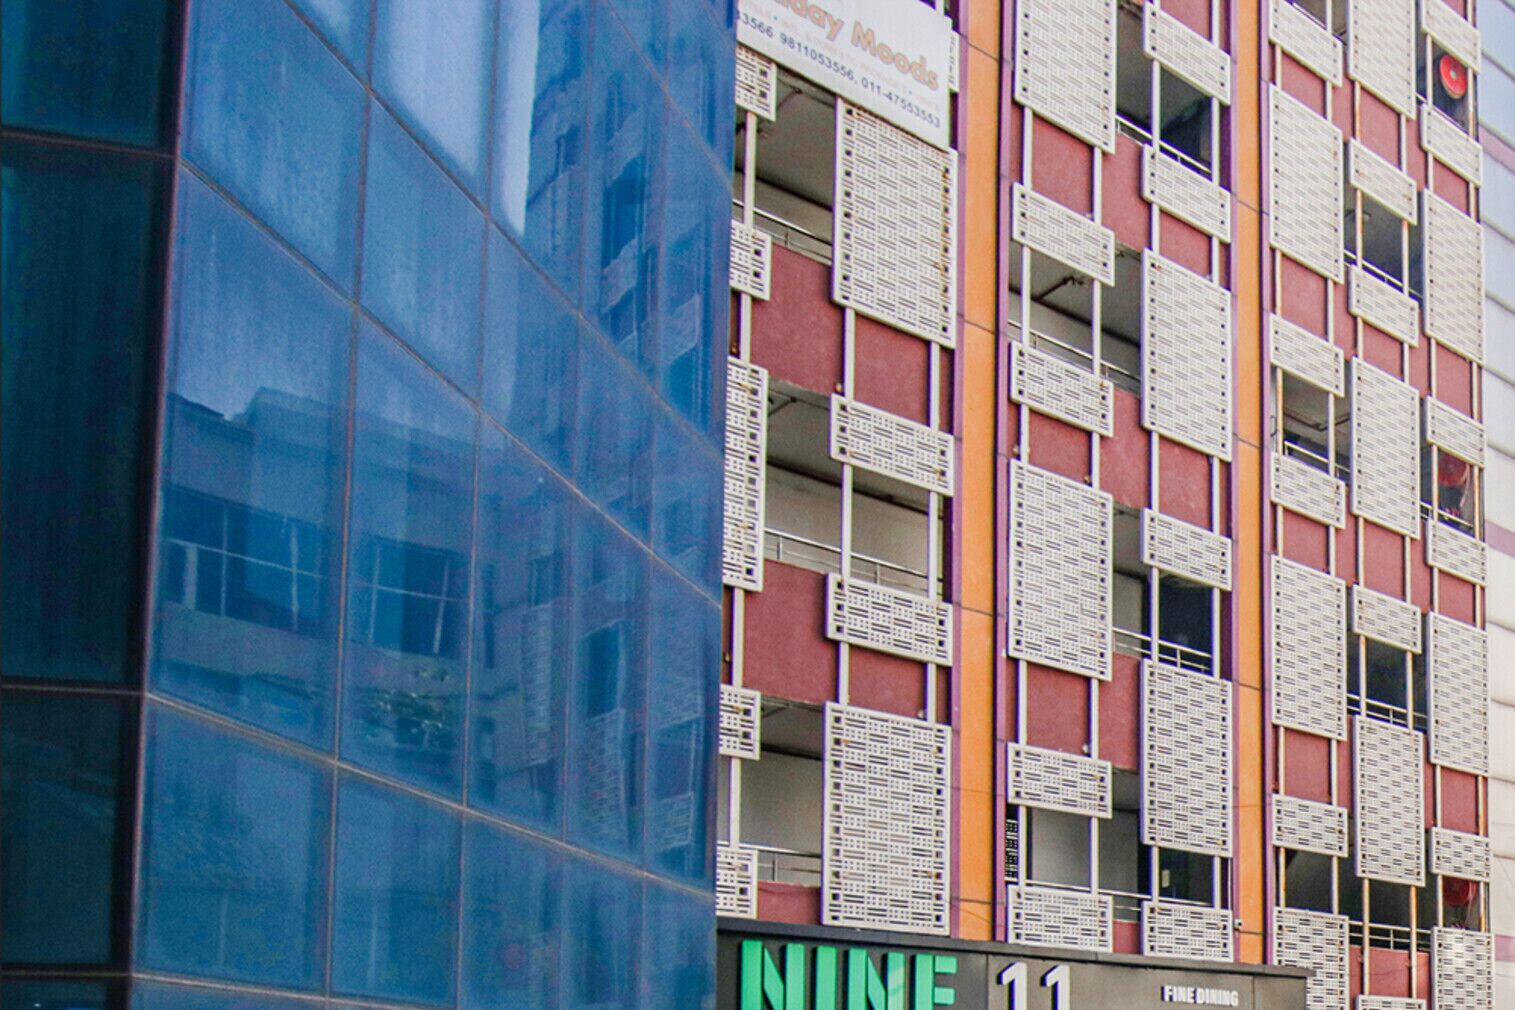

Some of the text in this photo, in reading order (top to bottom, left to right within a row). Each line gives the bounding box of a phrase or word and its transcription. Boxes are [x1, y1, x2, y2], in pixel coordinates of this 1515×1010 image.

[774, 0, 845, 42] day
[850, 20, 939, 91] Moods
[1162, 985, 1239, 1007] FINE DINING
